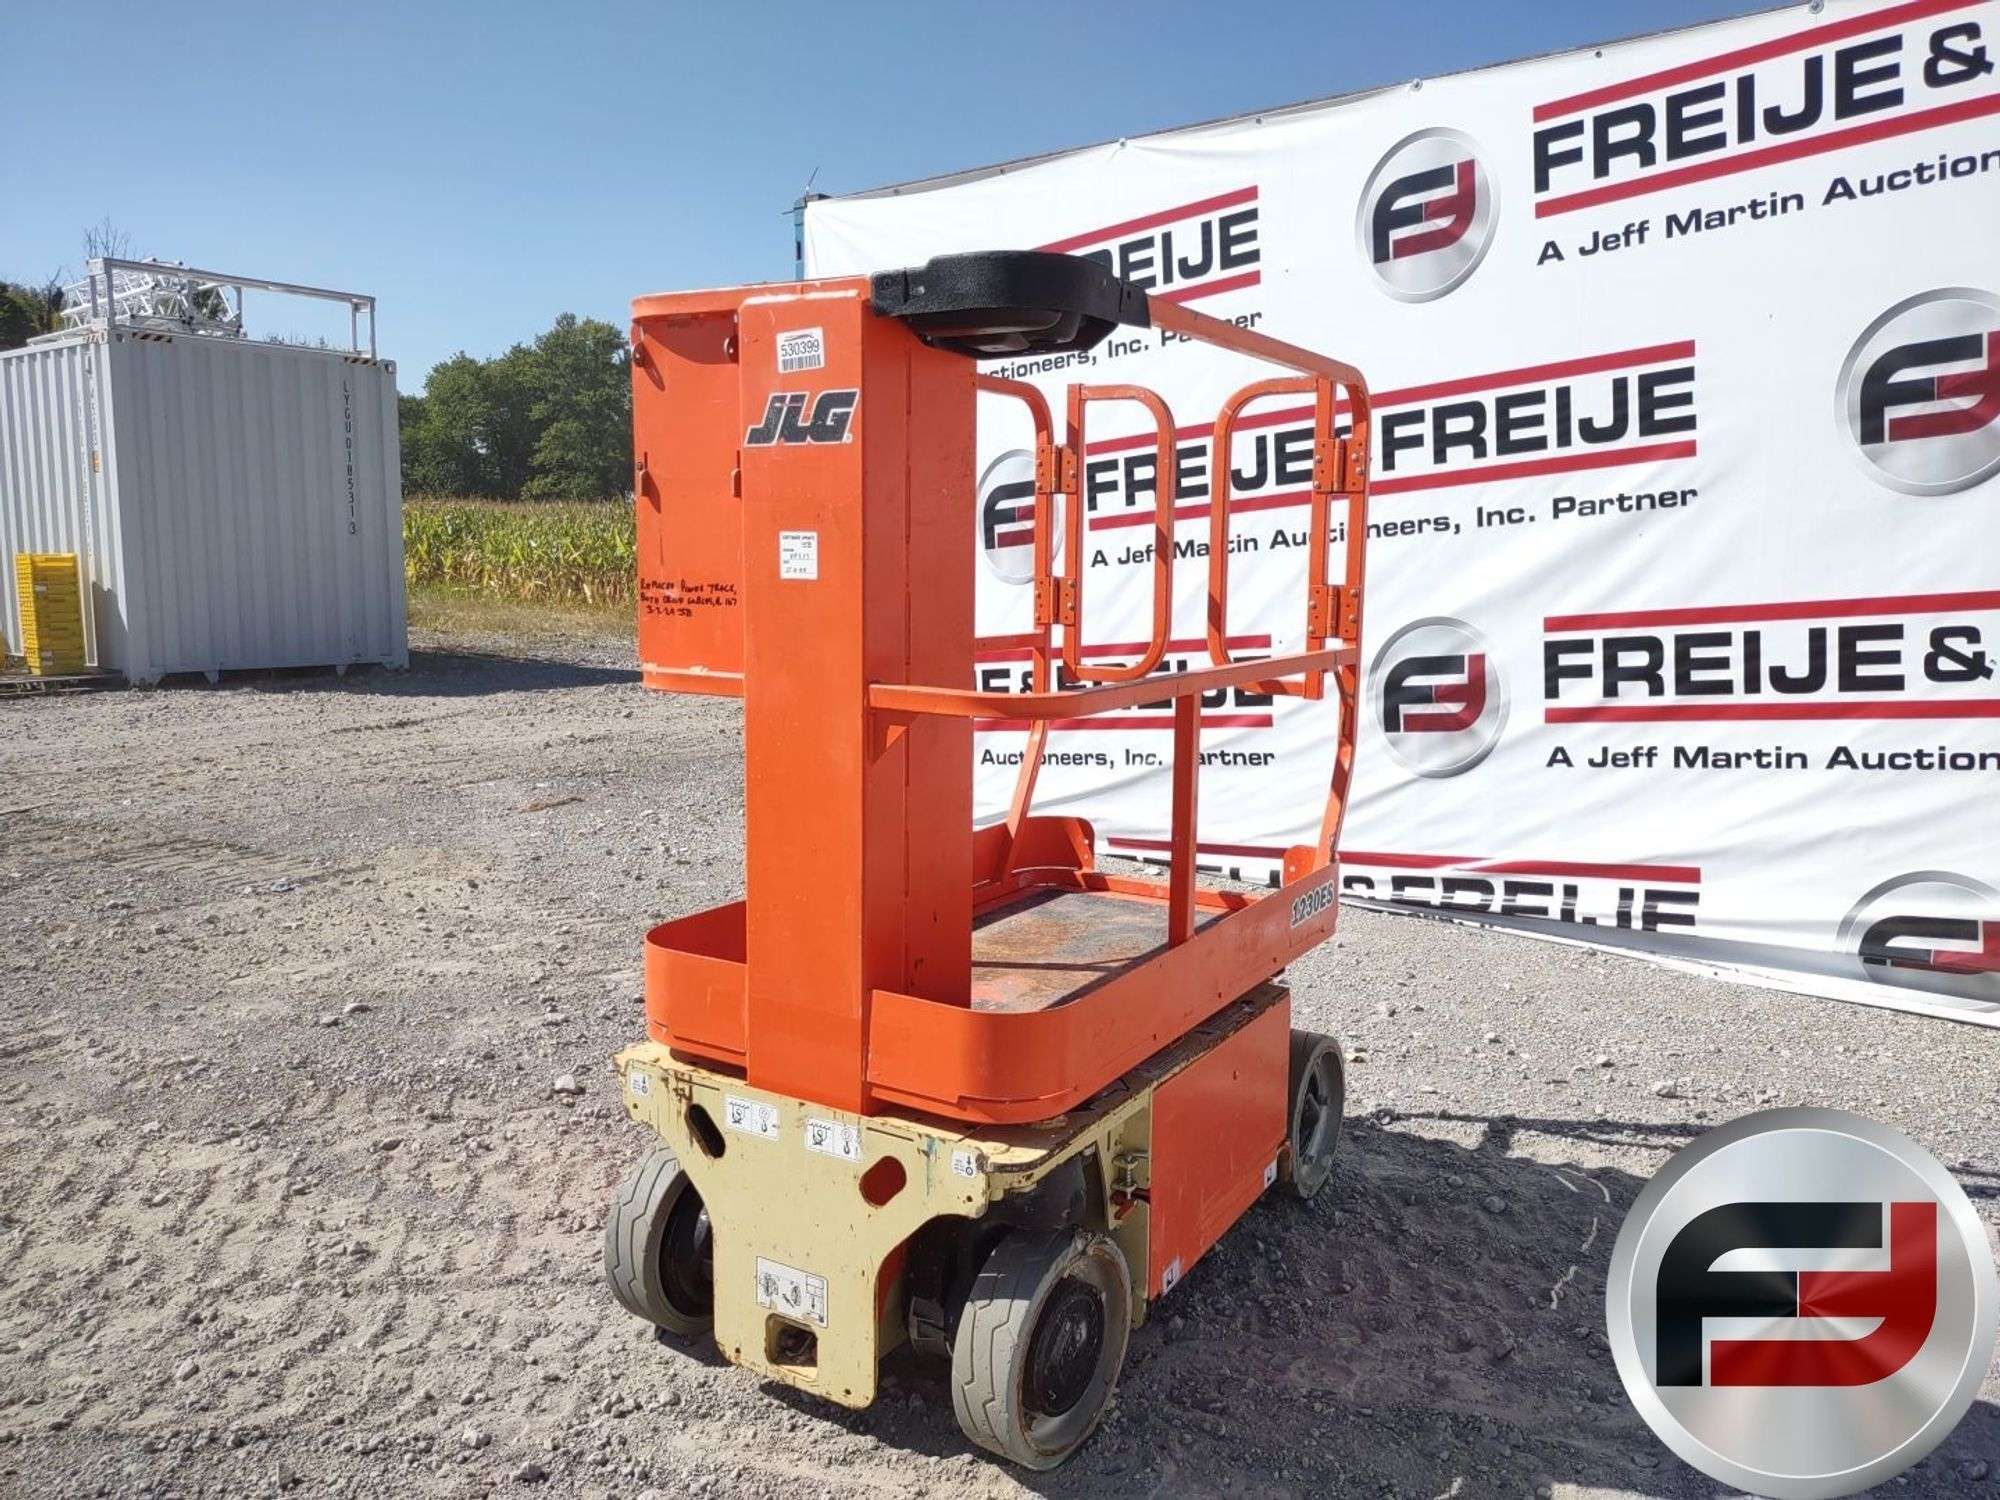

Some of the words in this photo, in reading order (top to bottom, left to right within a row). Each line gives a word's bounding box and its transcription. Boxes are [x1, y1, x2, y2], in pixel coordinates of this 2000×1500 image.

[1533, 33, 1904, 194] FREIJE
[1923, 20, 1994, 89] &
[1537, 241, 1565, 266] A
[1578, 219, 1651, 257] Jeff
[1665, 190, 1805, 239] Martin
[781, 338, 820, 358] 530399
[1107, 336, 1149, 358] Inc.
[744, 388, 859, 446] JLG
[1381, 366, 1697, 472] FREIJE
[1090, 549, 1109, 568] A
[1476, 505, 1536, 527] Inc.
[1552, 487, 1699, 520] Partner
[1543, 623, 1905, 700] FREIJE
[1923, 625, 1994, 683] &
[1124, 748, 1163, 766] Inc.
[1545, 745, 1574, 768] A
[1587, 745, 1658, 768] Jeff
[1673, 744, 1808, 769] Martin
[1825, 745, 2000, 771] Auction
[1291, 879, 1335, 928] 1230ES
